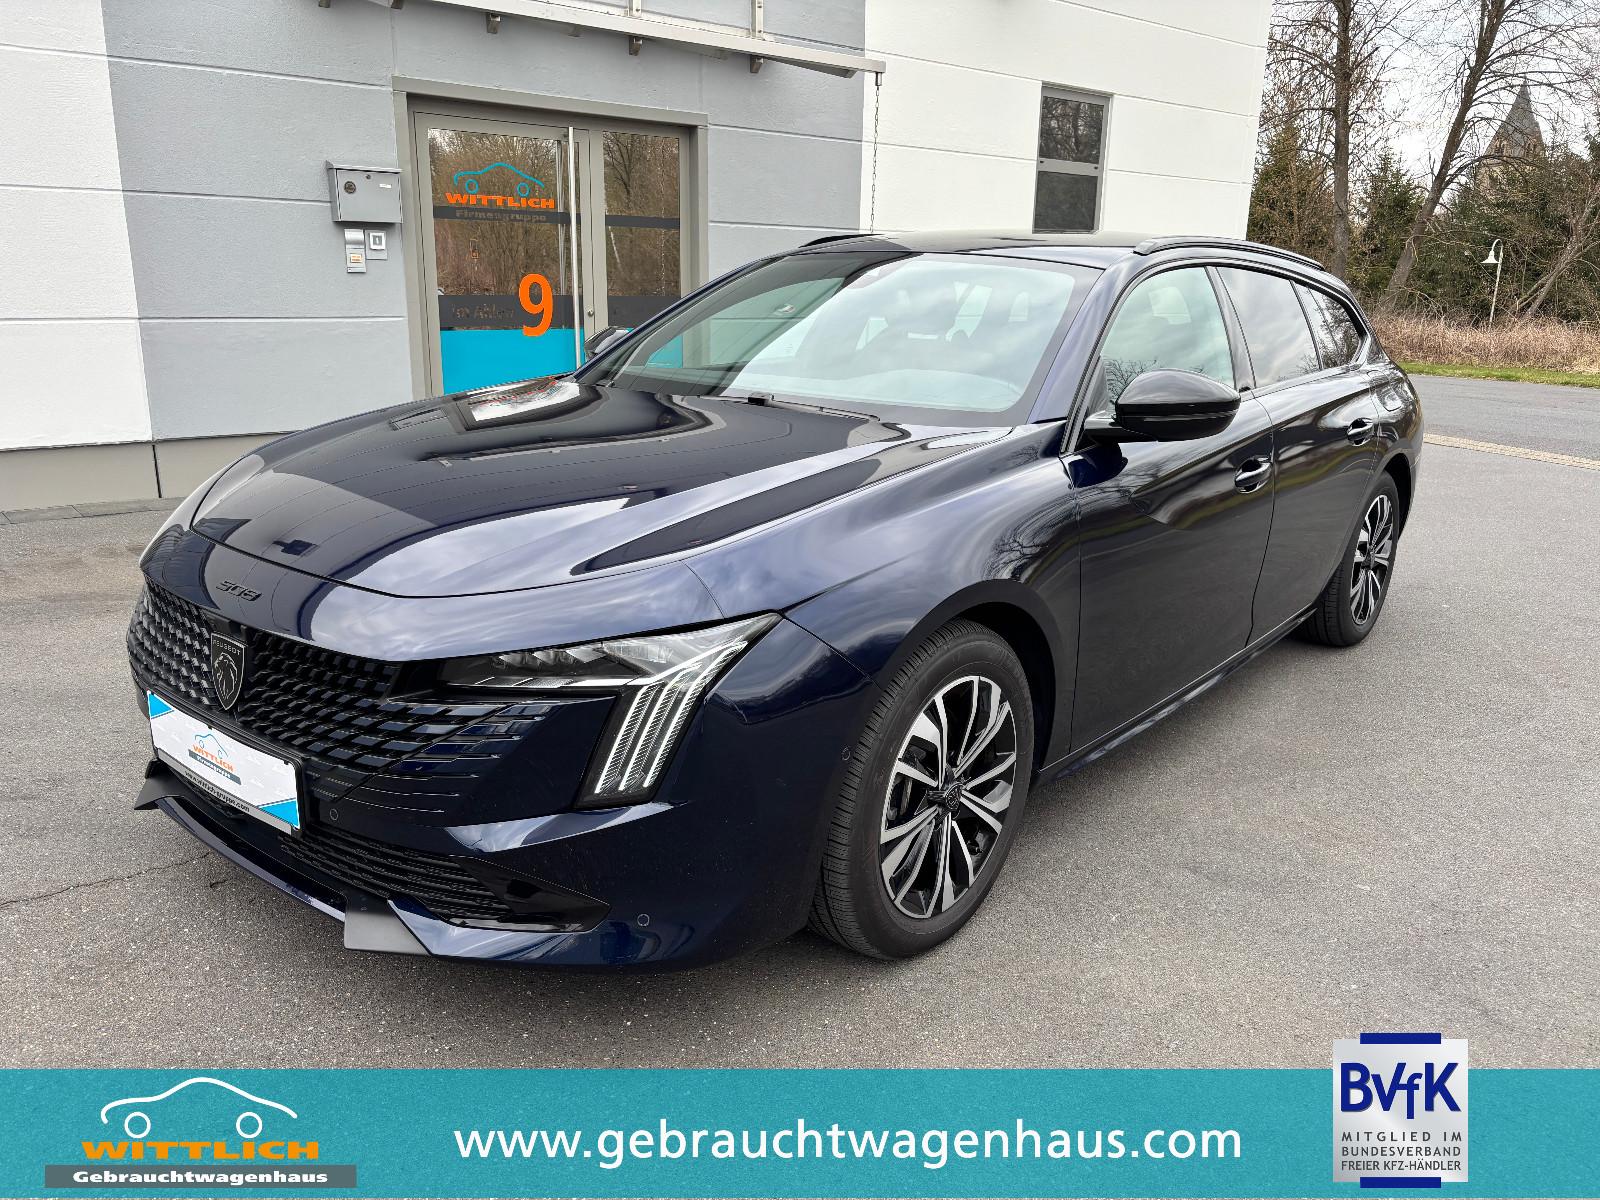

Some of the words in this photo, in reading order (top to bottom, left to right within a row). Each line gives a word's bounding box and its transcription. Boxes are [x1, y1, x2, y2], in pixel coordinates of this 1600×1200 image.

[445, 192, 555, 209] WITTLICH
[518, 273, 553, 337] 9
[215, 579, 263, 602] 508
[212, 639, 242, 656] PEUGEOT
[192, 744, 234, 772] WITTLICH
